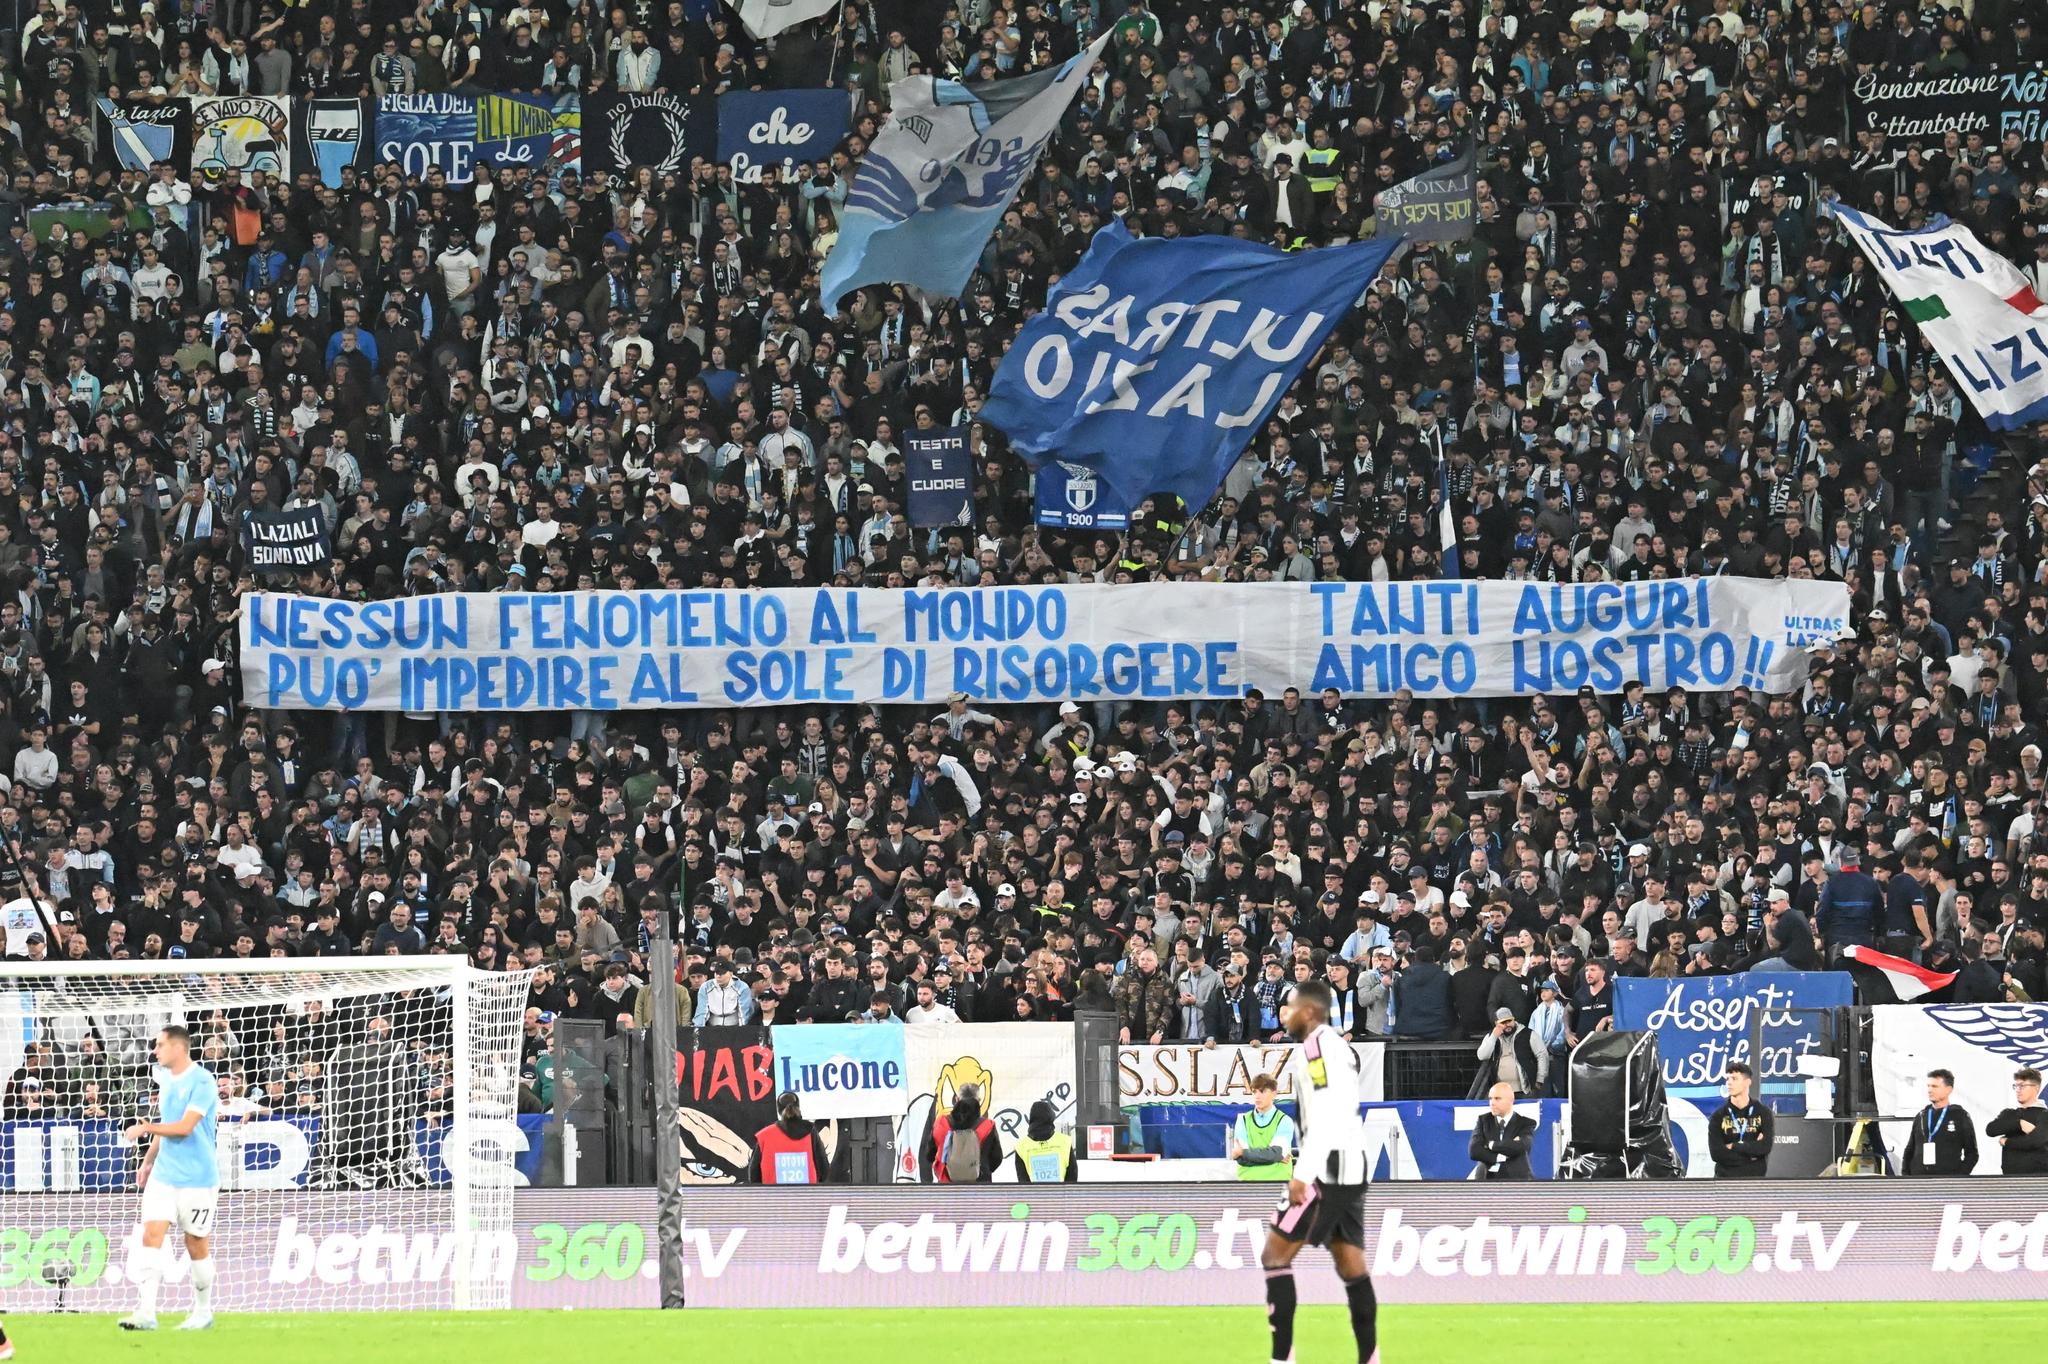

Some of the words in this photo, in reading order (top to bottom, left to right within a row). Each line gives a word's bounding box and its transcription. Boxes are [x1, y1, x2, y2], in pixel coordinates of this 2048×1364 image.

[1853, 73, 2000, 104] Generazione
[212, 100, 250, 119] VADO
[380, 93, 438, 114] FIGLIA
[440, 94, 473, 114] DEL
[606, 103, 627, 121] no
[629, 92, 691, 121] bullshit
[748, 107, 815, 145] che
[495, 136, 533, 162] Le
[382, 141, 473, 184] SOLE
[909, 438, 963, 451] TESTA
[931, 459, 943, 470] E
[912, 478, 966, 491] CUORE
[257, 517, 319, 543] LAZIALI
[1065, 512, 1094, 526] 1900
[253, 546, 293, 565] SONO
[293, 542, 326, 565] QVA
[250, 596, 468, 650] NESSUN
[500, 591, 788, 650] FENOMENO
[810, 588, 877, 645] AL
[904, 587, 1067, 643] MONDO
[1310, 582, 1480, 637] TANTI
[1513, 577, 1710, 635] AUGURI
[1784, 615, 1843, 631] ULTRAS
[269, 653, 381, 708] PUO'
[401, 655, 621, 710] IMPEDIRE
[629, 652, 698, 704] AL
[723, 648, 854, 703] SOLE
[883, 647, 926, 701] DI
[1311, 640, 1477, 693] AMICO
[780, 1056, 900, 1094] Lucone
[191, 1208, 209, 1225] 77
